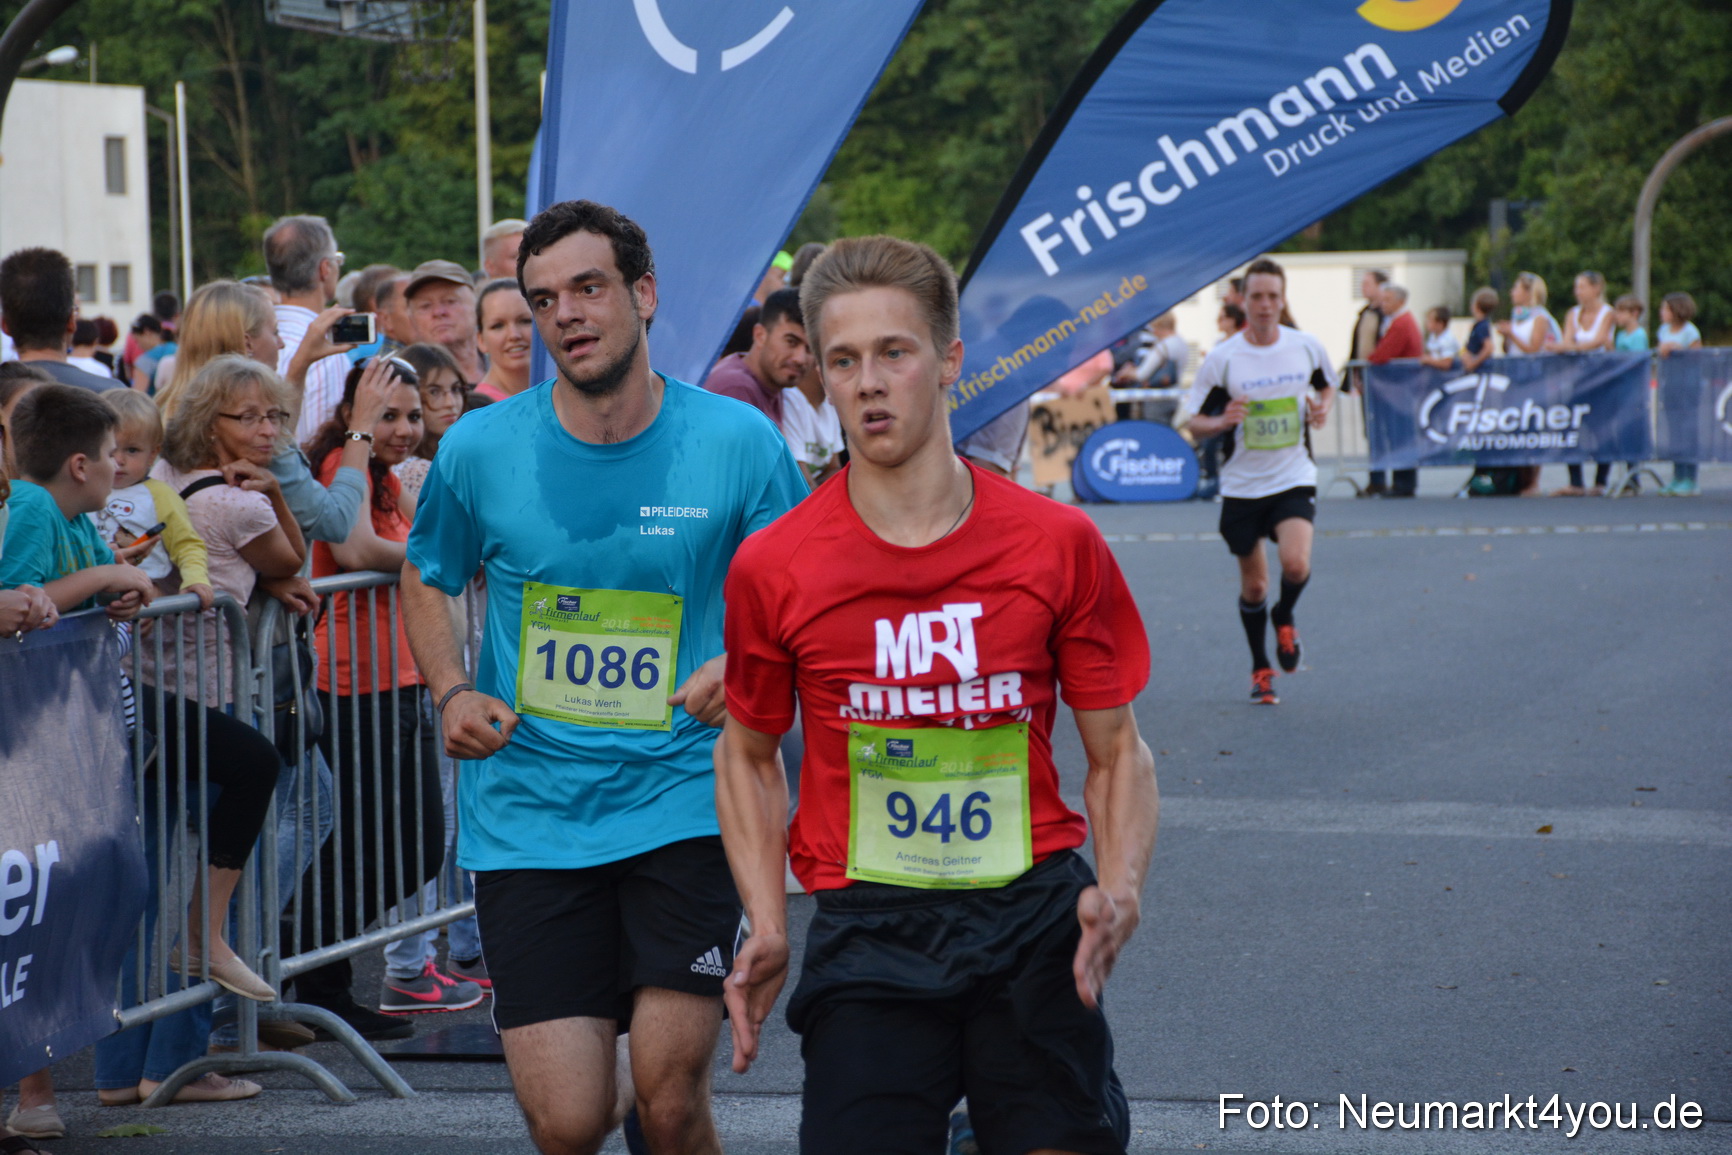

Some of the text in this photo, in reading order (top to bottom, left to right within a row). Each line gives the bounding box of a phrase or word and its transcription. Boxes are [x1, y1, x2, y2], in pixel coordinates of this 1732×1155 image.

[1263, 14, 1531, 177] Druck und Medien
[1020, 43, 1397, 276] Frischmann
[1447, 398, 1590, 435] Fischer
[1255, 417, 1288, 437] 301
[1458, 431, 1578, 451] AUTOMOBILE
[1109, 453, 1186, 475] Fischer
[651, 507, 709, 518] PFLEIDERER
[640, 525, 675, 536] Lukas
[545, 606, 601, 622] firmenlauf
[875, 602, 982, 683] MRT
[536, 639, 660, 691] 1086
[564, 694, 622, 709] Lukas Werth
[848, 671, 1022, 717] MEIER
[875, 753, 938, 768] firmenlauf
[886, 791, 992, 843] 946
[896, 851, 982, 866] Andreas Geitner
[690, 963, 727, 977] adidas
